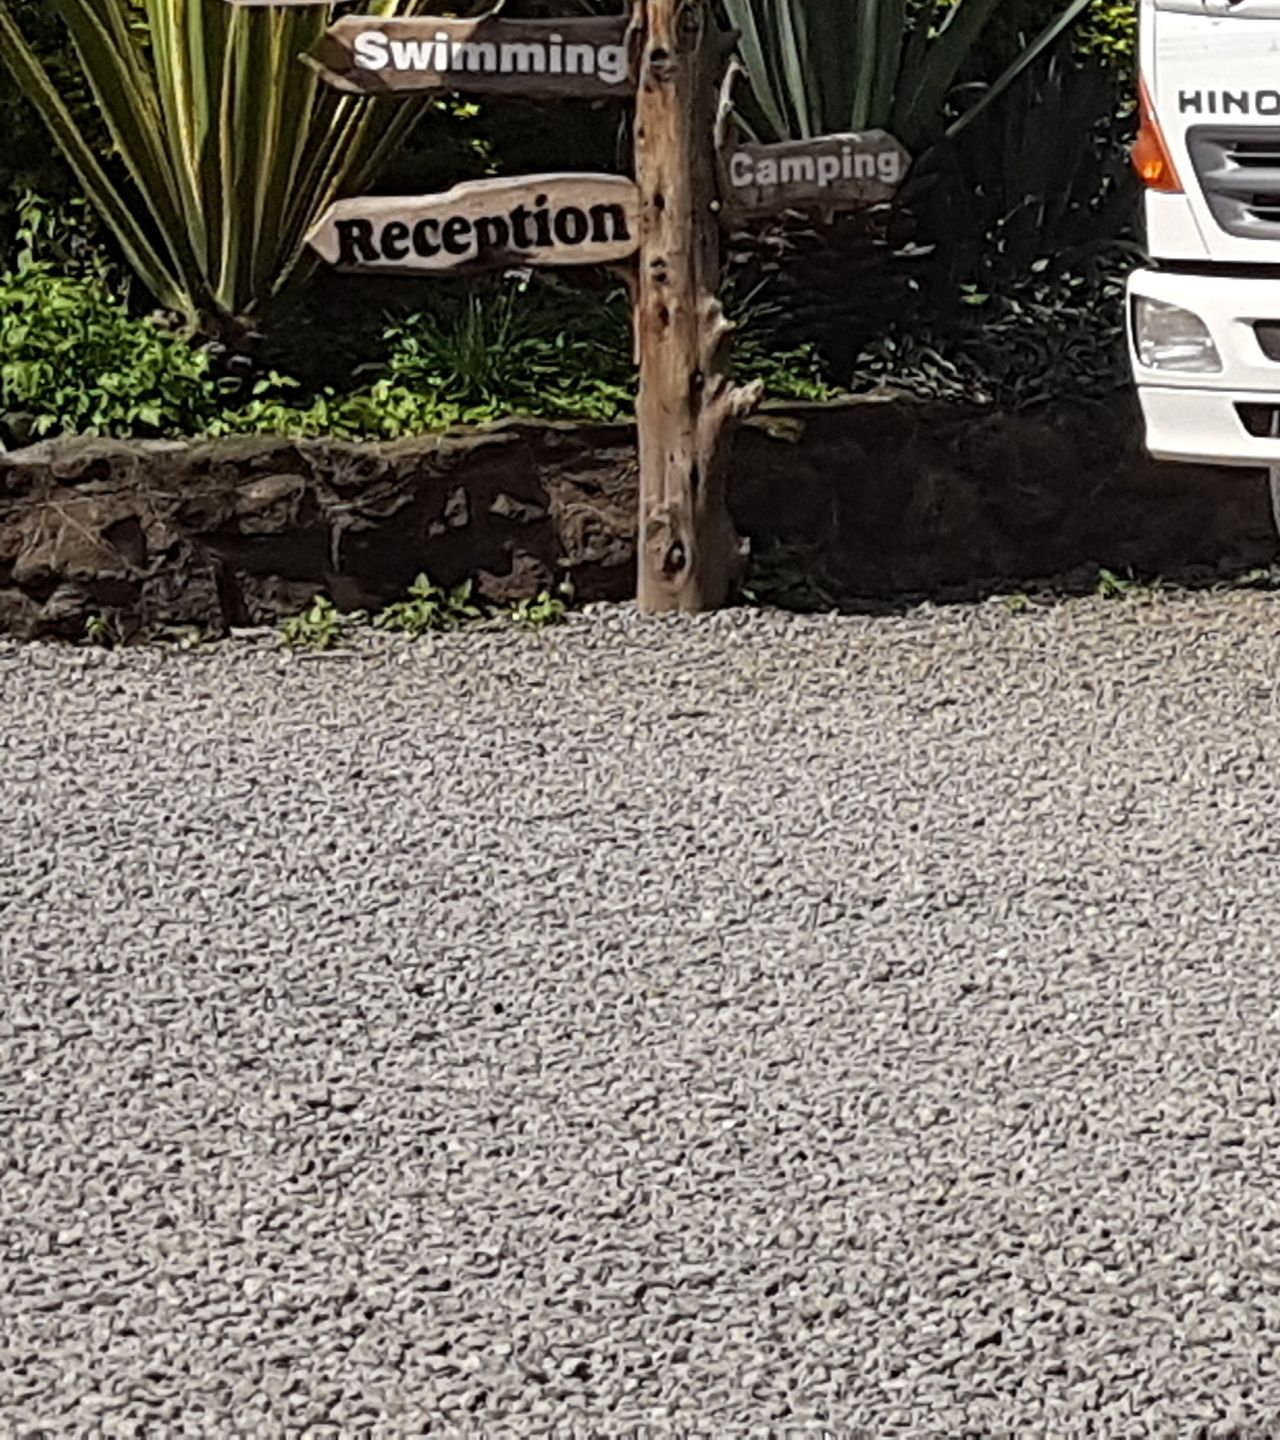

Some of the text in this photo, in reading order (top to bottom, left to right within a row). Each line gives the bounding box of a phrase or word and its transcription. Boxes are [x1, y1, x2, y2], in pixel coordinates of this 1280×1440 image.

[354, 31, 628, 85] Swimming
[729, 146, 903, 191] Camping
[333, 195, 631, 267] Reception
